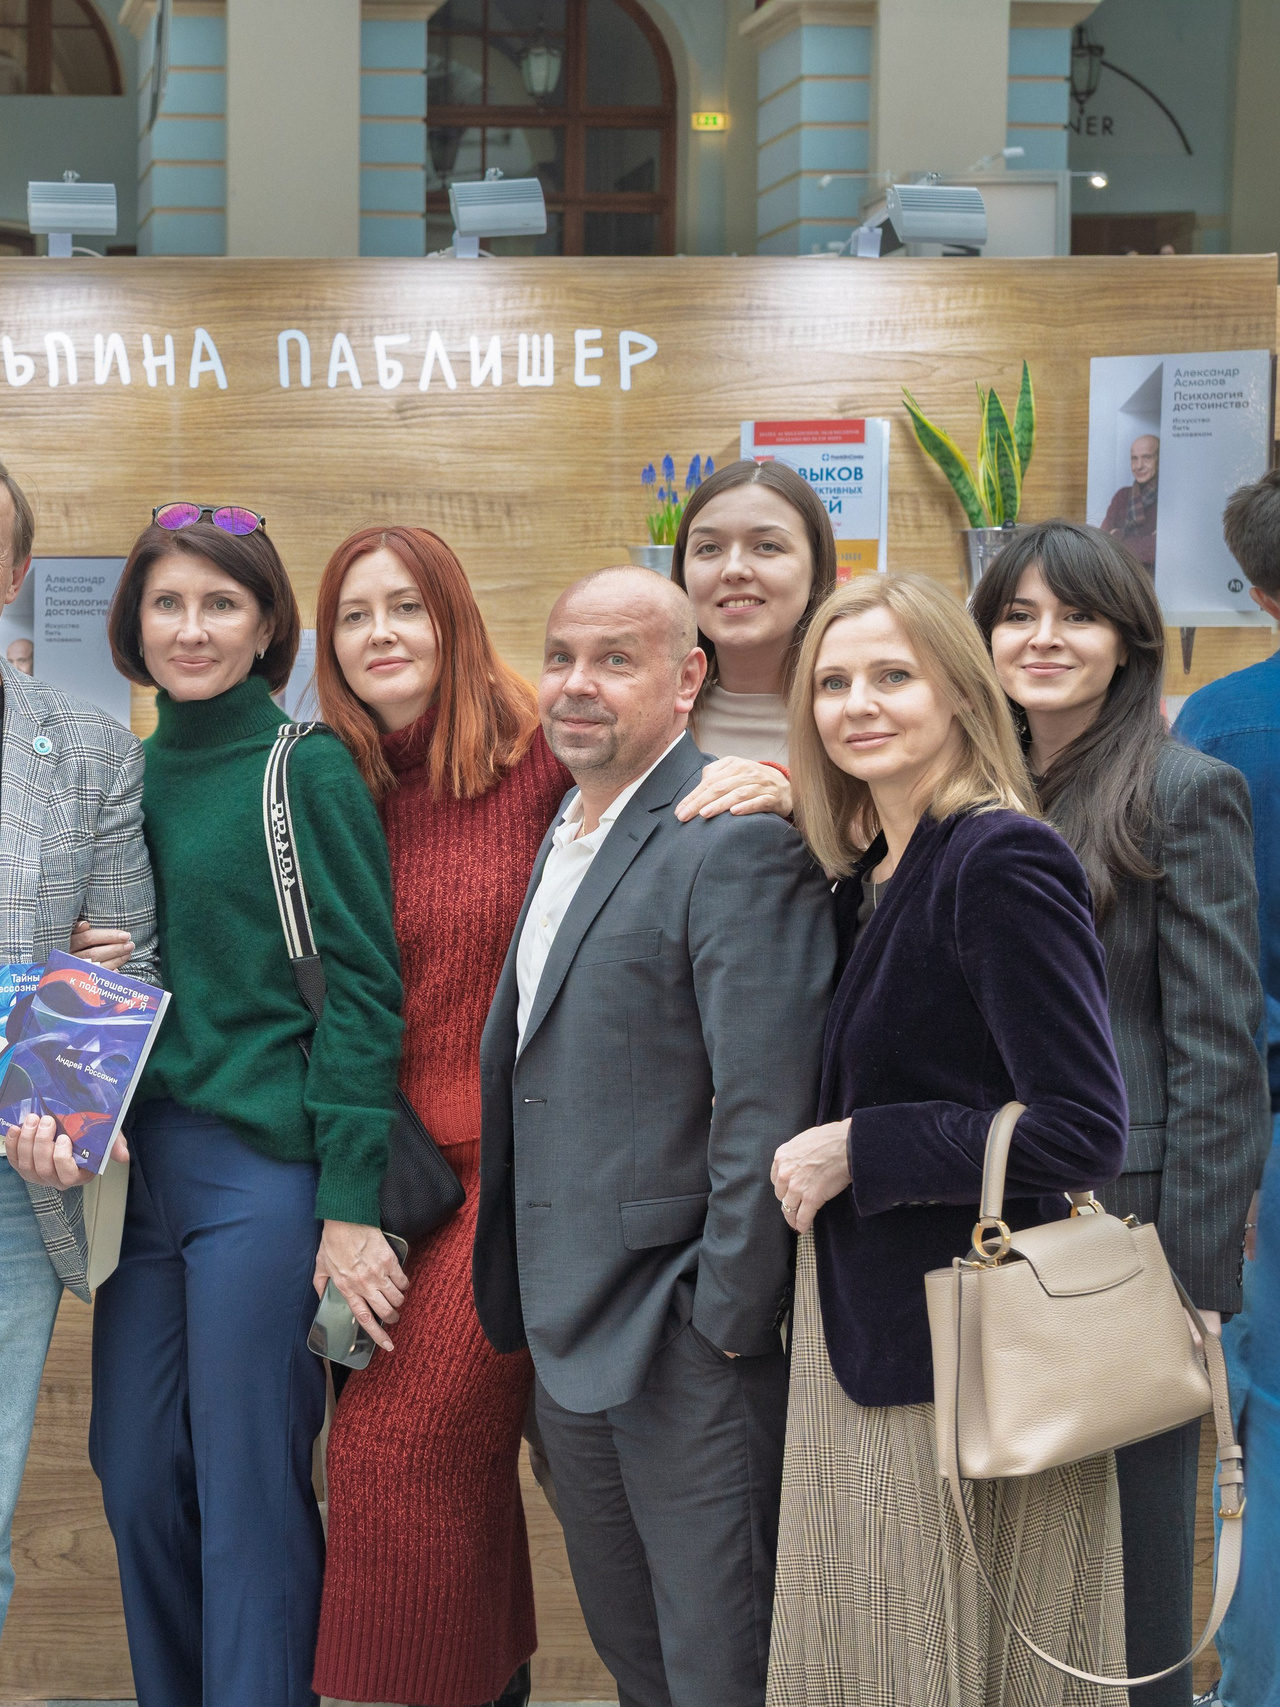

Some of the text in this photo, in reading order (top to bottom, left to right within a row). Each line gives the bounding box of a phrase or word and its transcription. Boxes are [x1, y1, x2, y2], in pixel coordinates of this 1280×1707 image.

[278, 328, 659, 392] ПАБЛИШЕР
[1174, 368, 1240, 379] Александр
[1174, 377, 1226, 387] Асмолов
[1173, 390, 1244, 402] Психология
[798, 466, 864, 482] ВЫКОВ
[44, 574, 106, 587] Александр
[44, 583, 93, 593] Асмолов
[44, 596, 109, 607] Психология
[44, 608, 107, 617] достоинств
[44, 623, 80, 631] Искусство
[272, 800, 296, 892] PRADA
[10, 973, 41, 983] Тайны
[87, 971, 150, 1003] Путешествие
[69, 977, 148, 1013] к подлинному Я
[55, 1054, 119, 1085] Андрей Россохин
